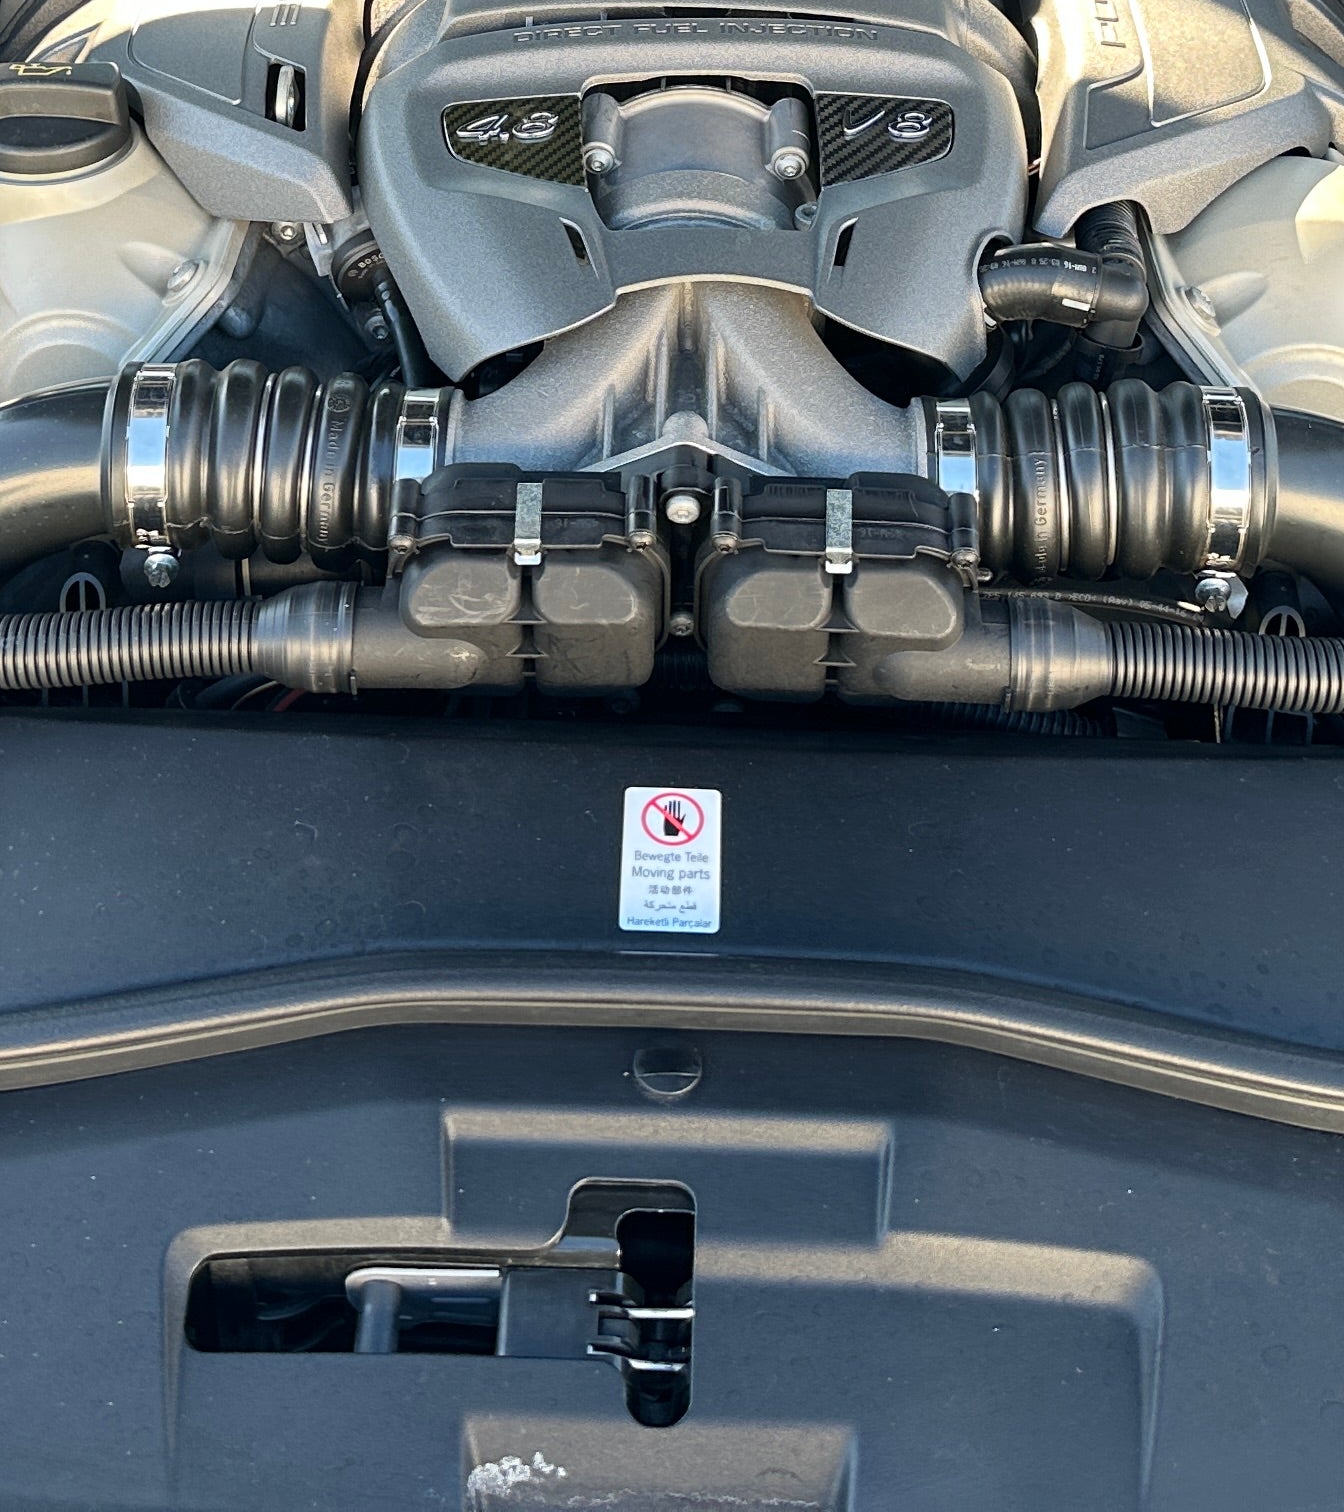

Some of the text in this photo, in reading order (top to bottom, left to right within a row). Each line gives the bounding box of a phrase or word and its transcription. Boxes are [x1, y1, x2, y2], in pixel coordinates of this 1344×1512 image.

[512, 22, 878, 42] DIRECT FUEL INJECTION
[455, 112, 559, 142] 4.8
[357, 252, 385, 269] BOSC
[326, 419, 345, 459] Made
[324, 464, 336, 476] in
[1034, 458, 1048, 526] Germany
[634, 850, 709, 863] Bewegte Teile
[632, 866, 711, 880] Moving parts
[627, 916, 712, 929] Hareketli Parçalar
